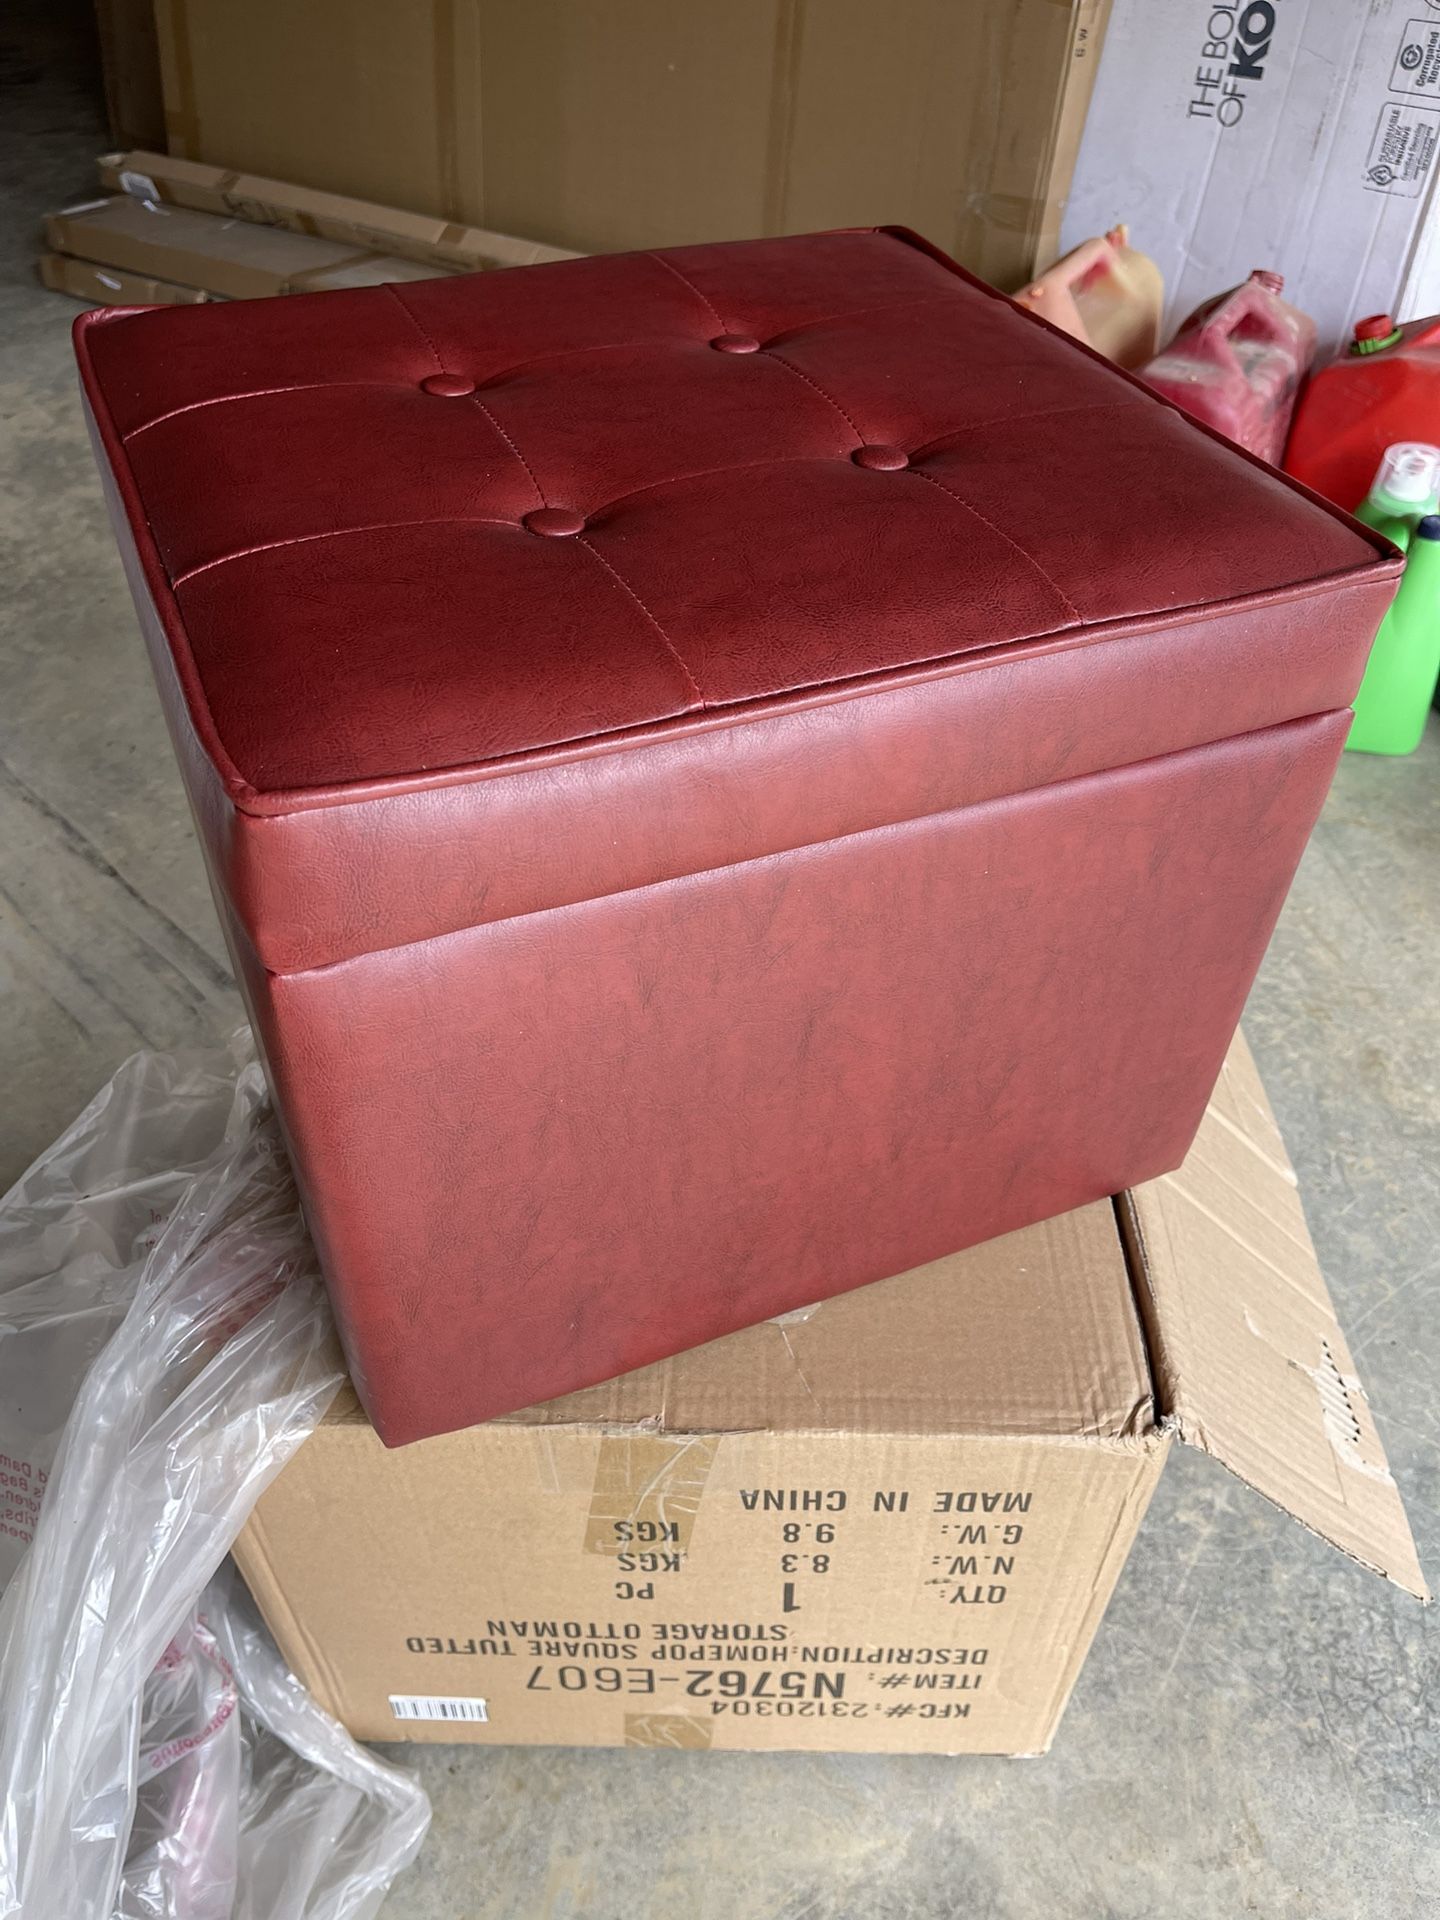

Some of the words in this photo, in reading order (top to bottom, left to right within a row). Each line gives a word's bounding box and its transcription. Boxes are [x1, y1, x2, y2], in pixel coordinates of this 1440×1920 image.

[1227, 0, 1276, 81] KO
[1415, 31, 1440, 87] Corrugated
[1186, 65, 1224, 118] THE
[1216, 82, 1247, 128] OF
[739, 1489, 847, 1512] CHINA
[873, 1491, 909, 1512] IN
[933, 1492, 1032, 1513] MADE
[613, 1520, 680, 1542] KGS
[783, 1522, 835, 1544] 9.8
[618, 1552, 681, 1573] KGS
[781, 1553, 830, 1574] 8.3
[615, 1581, 655, 1600] PC
[783, 1582, 801, 1613] 1
[939, 1584, 1007, 1604] QTY:
[487, 1619, 641, 1640] OTTOMAN
[651, 1622, 788, 1641] STORAGE
[406, 1636, 516, 1657] TUFTED
[529, 1640, 638, 1660] SQUARE
[526, 1665, 846, 1699] N5762-E607
[868, 1672, 983, 1690] ITEM#:
